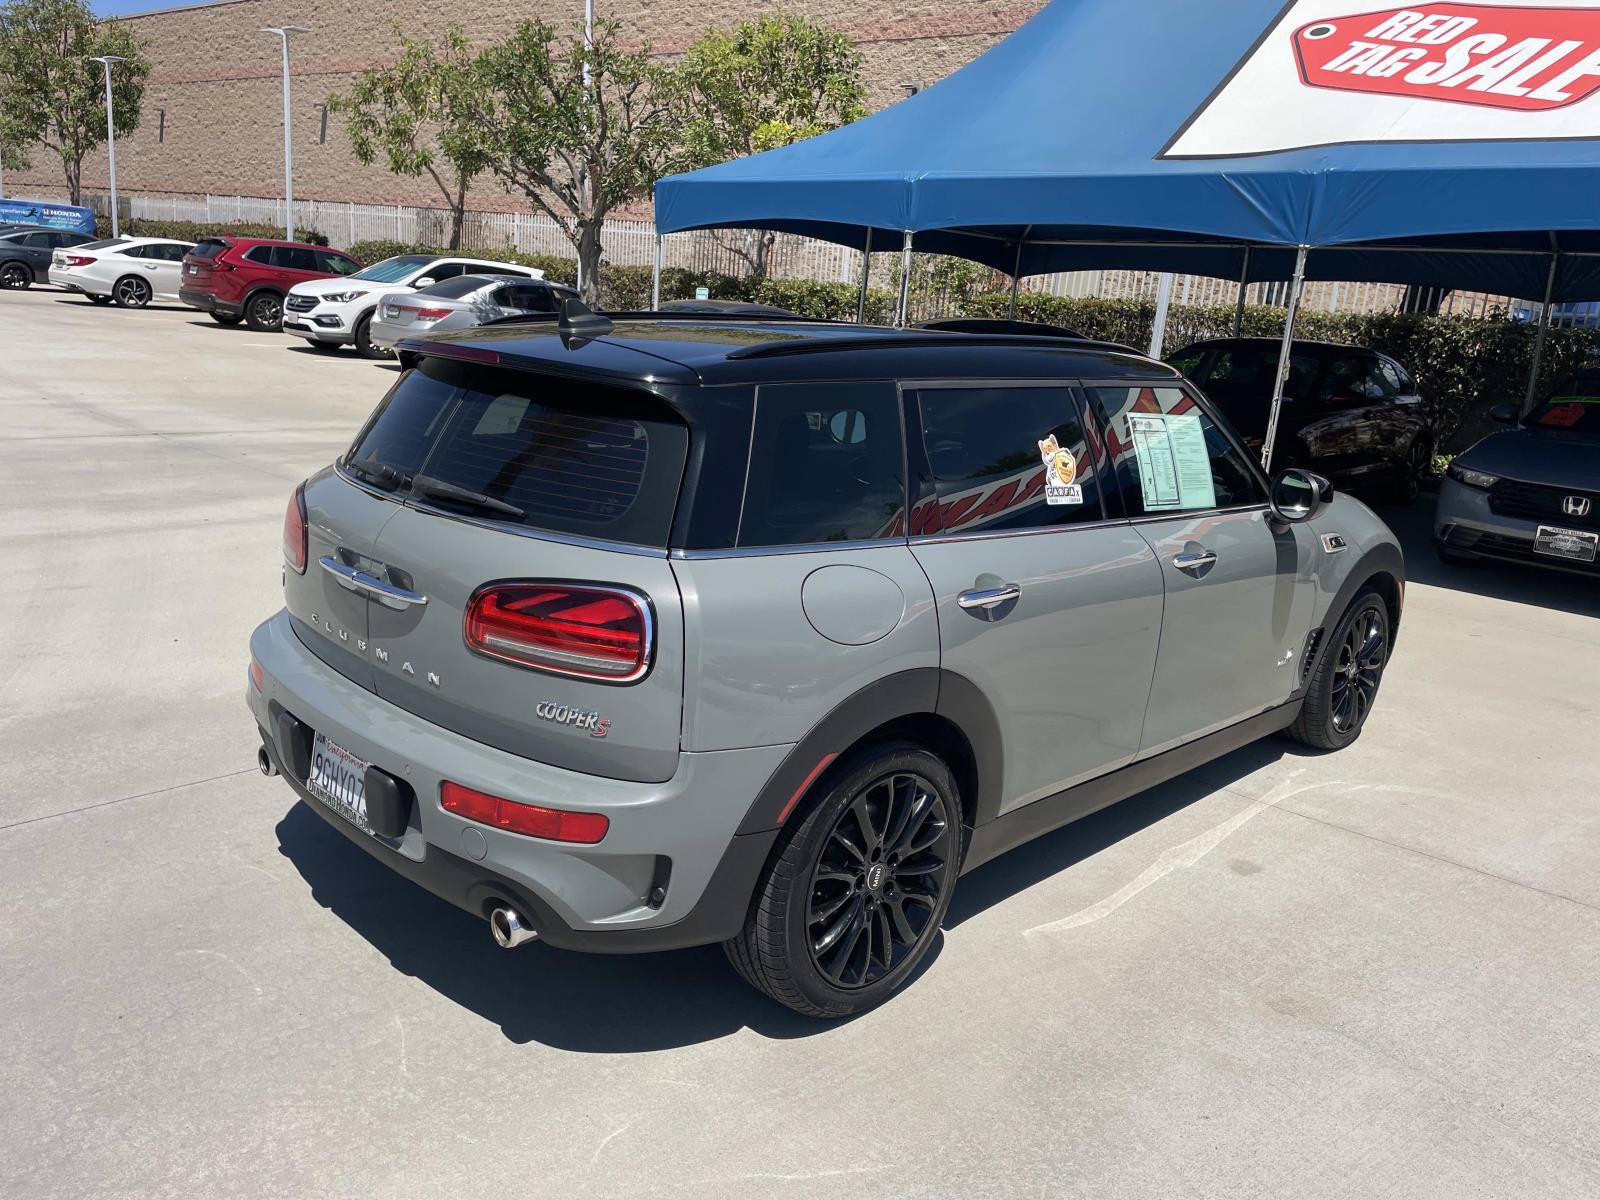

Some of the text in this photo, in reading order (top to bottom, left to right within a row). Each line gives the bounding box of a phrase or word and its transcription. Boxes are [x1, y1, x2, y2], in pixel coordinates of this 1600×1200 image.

[1363, 10, 1479, 45] RED
[1320, 40, 1428, 78] TAG
[50, 209, 81, 218] HONDA
[1047, 486, 1080, 497] CARFAX
[311, 613, 440, 686] CLUBMAN
[536, 701, 611, 737] COOPER S
[327, 743, 364, 769] California
[315, 753, 368, 817] 9GHY07
[873, 868, 882, 887] MINI
